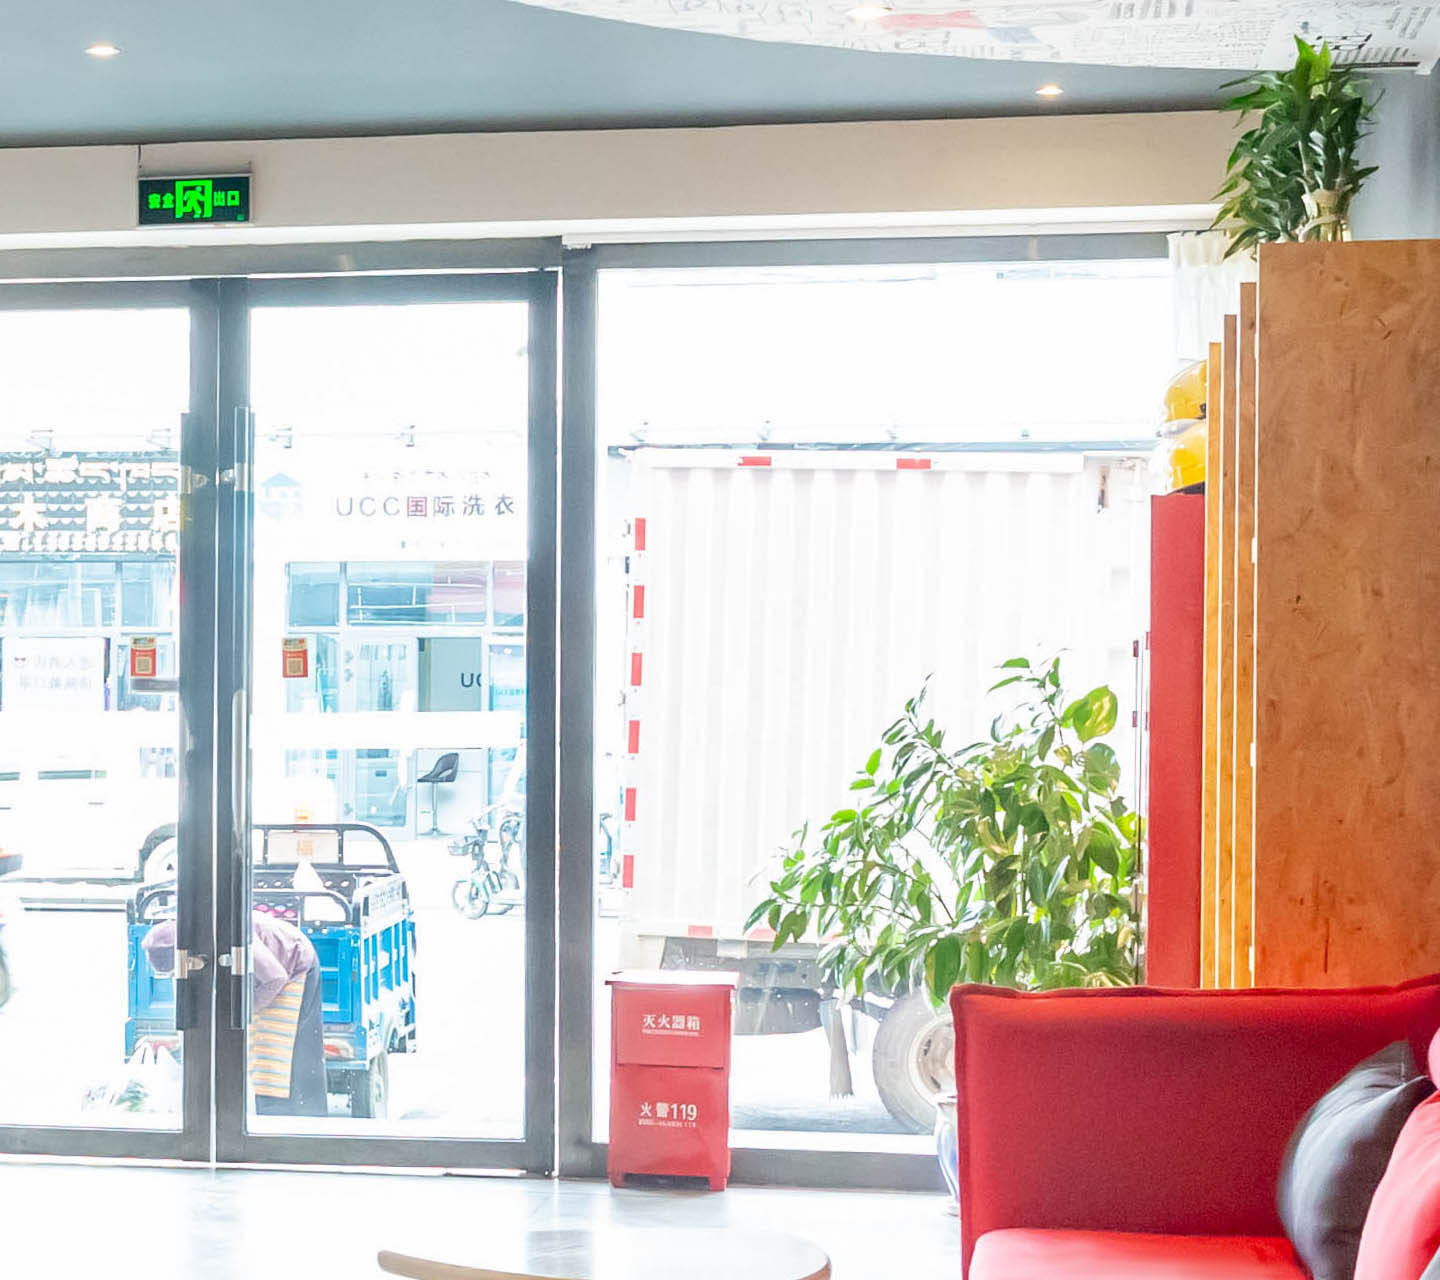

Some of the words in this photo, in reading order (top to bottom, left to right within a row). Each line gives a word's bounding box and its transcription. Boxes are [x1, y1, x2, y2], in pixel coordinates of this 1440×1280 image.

[335, 493, 516, 518] UCC国际洗衣
[642, 1014, 701, 1031] 灭火器箱
[639, 1101, 698, 1121] 火警119
